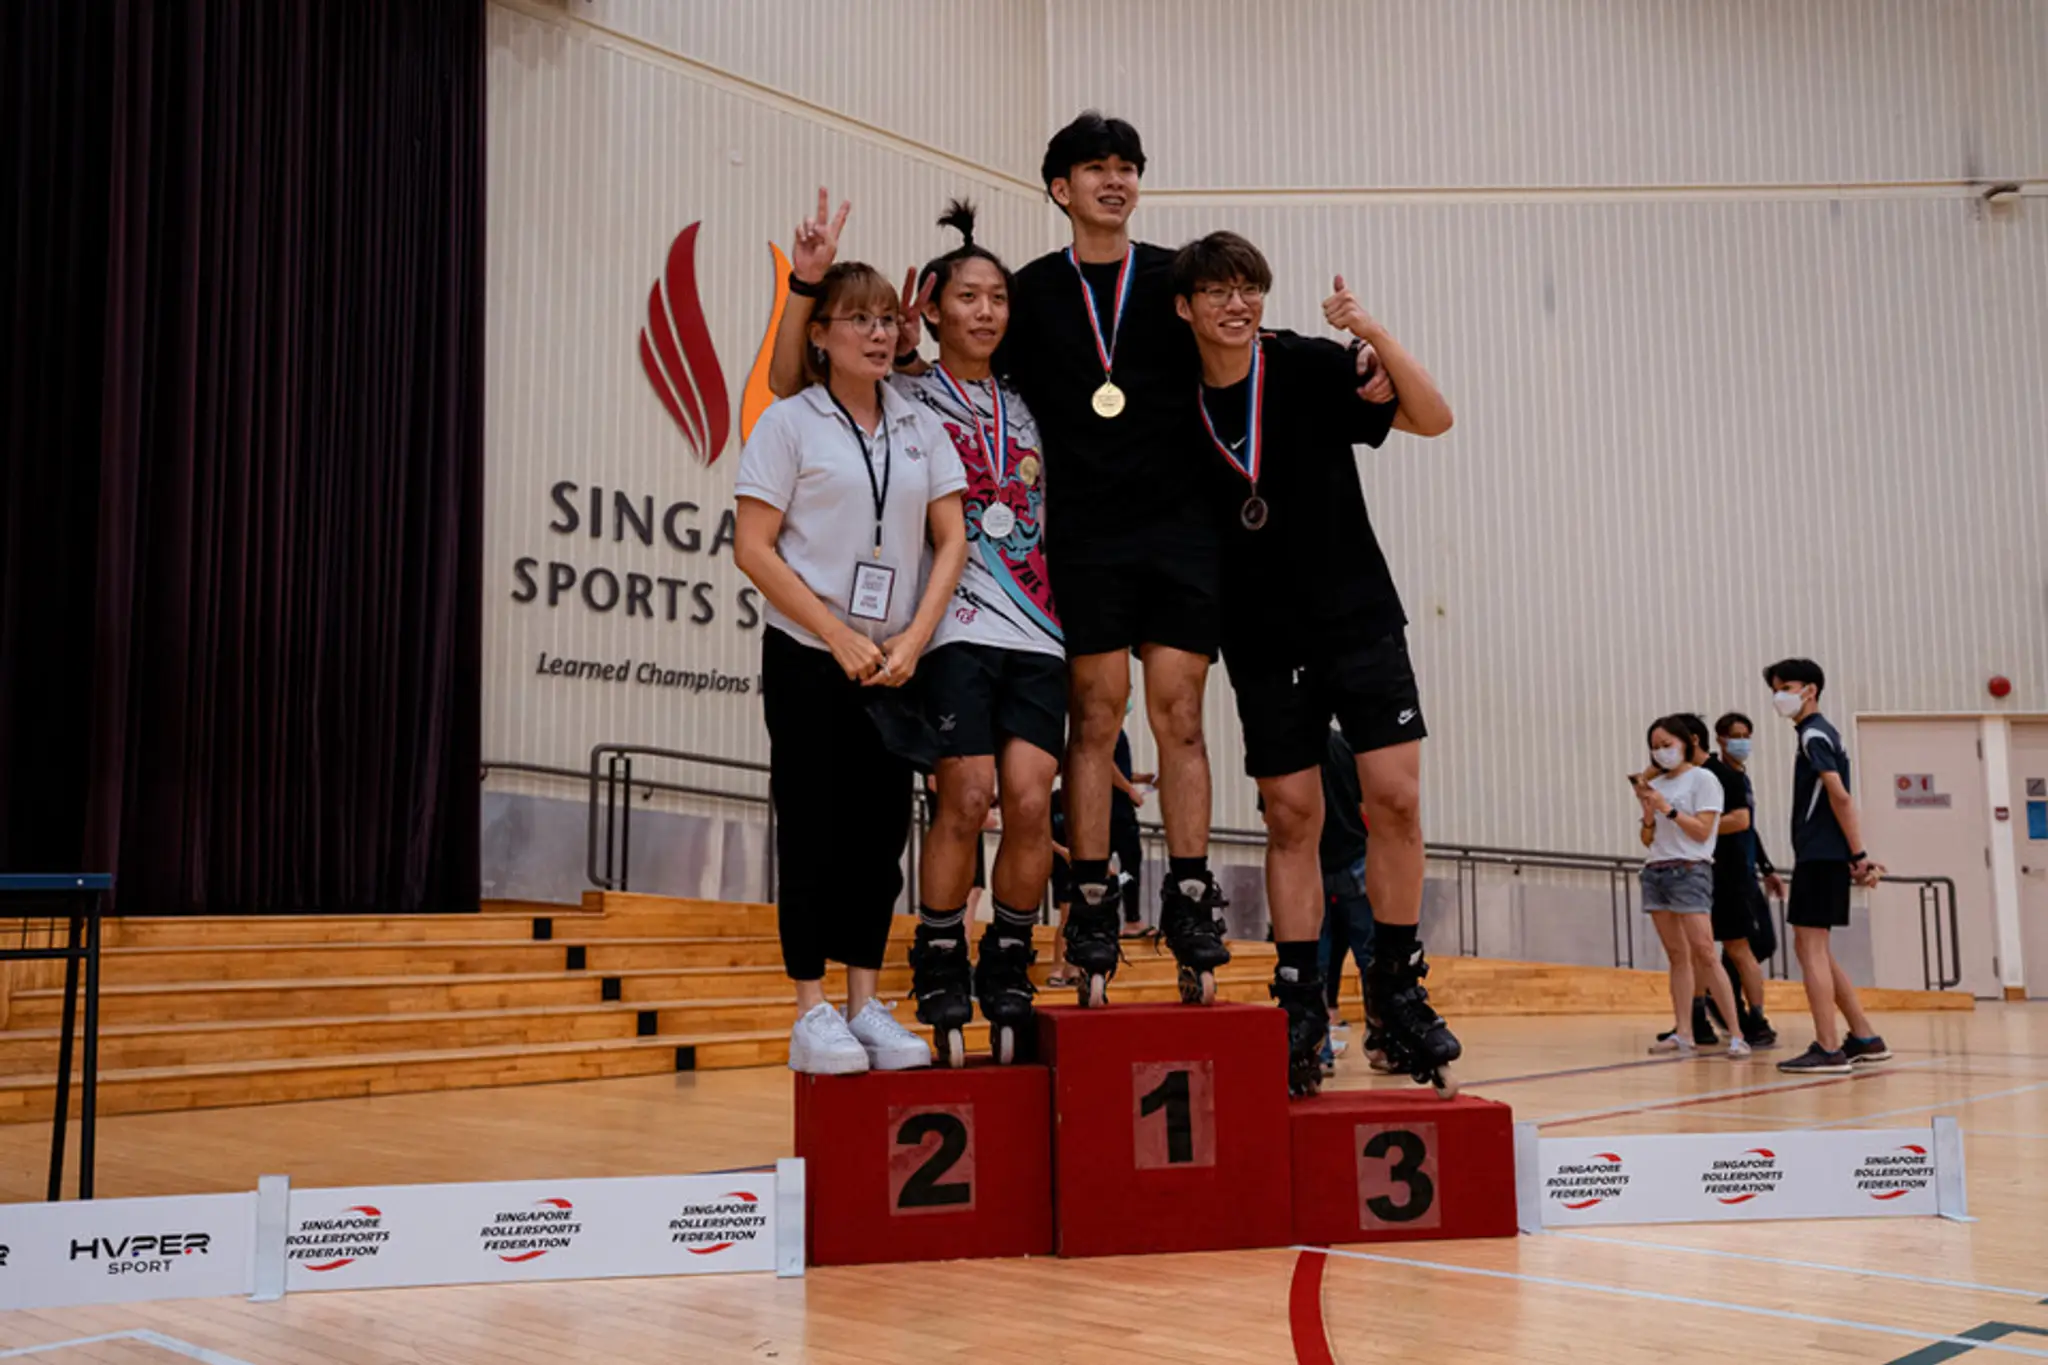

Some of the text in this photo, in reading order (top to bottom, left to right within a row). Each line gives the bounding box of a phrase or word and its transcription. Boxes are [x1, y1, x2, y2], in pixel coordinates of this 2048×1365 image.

[511, 557, 714, 625] SPORTS
[536, 652, 630, 682] Learned
[635, 663, 750, 694] Champions
[1140, 1071, 1194, 1164] 1
[896, 1112, 971, 1209] 2
[1712, 1160, 1775, 1169] SINGAPORE
[1864, 1156, 1926, 1165] SINGAPORE
[1557, 1164, 1622, 1174] SINGAPORE
[1854, 1167, 1934, 1177] ROLLERSPORTS
[1363, 1130, 1434, 1222] 3
[1546, 1176, 1629, 1186] ROLLERSPORTS
[1702, 1171, 1783, 1181] ROLLERSPORTS
[1704, 1183, 1775, 1193] FEDERATION
[1857, 1179, 1927, 1189] FEDERATION
[1550, 1188, 1622, 1198] FEDERATION
[682, 1203, 757, 1216] SINGAPORE
[495, 1211, 573, 1223] SINGAPORE
[669, 1216, 766, 1229] ROLLERSPORTS
[301, 1218, 380, 1231] SINGAPORE
[480, 1223, 581, 1237] ROLLERSPORTS
[285, 1231, 390, 1245] ROLLERSPORTS
[672, 1231, 757, 1242] FEDERATION
[484, 1238, 571, 1250] FEDERATION
[288, 1246, 379, 1259] FEDERATION
[107, 1259, 173, 1275] SPORT
